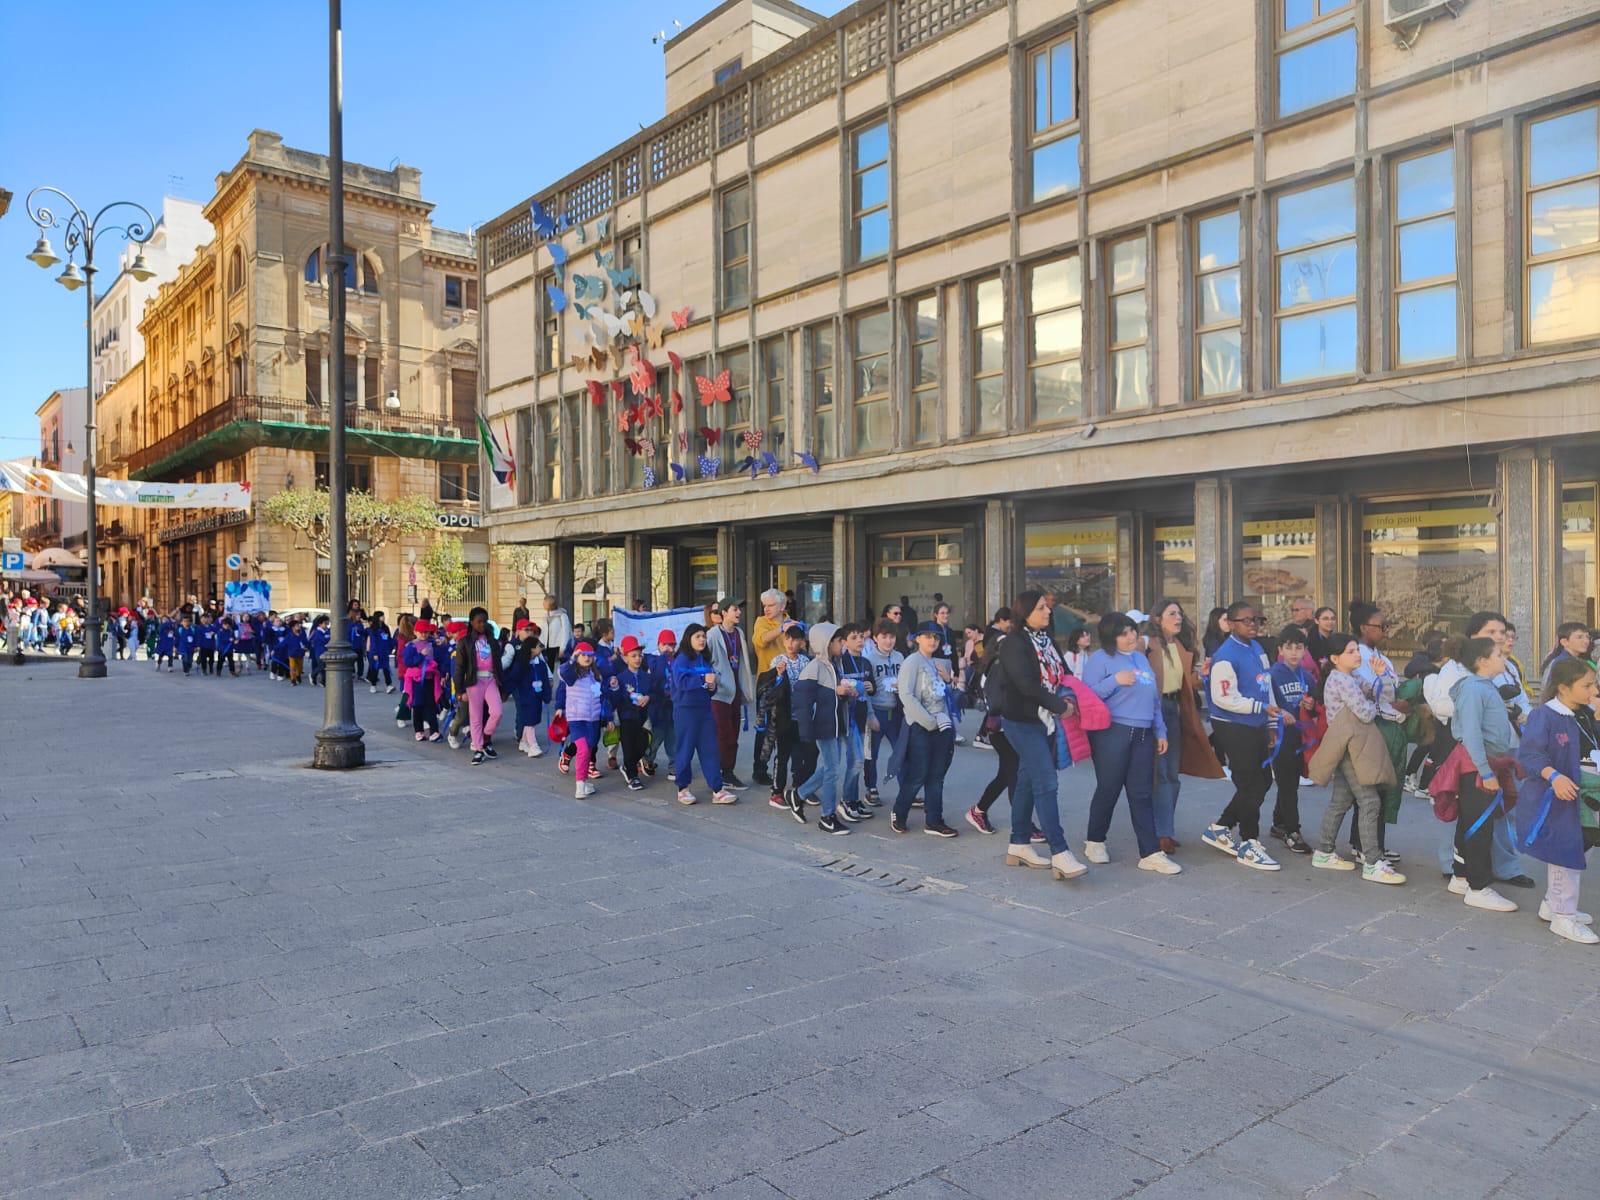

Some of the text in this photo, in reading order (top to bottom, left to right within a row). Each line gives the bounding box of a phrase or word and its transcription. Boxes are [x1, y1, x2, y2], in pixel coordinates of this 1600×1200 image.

[436, 514, 480, 527] OPOL
[1397, 514, 1422, 526] point
[6, 553, 20, 569] P
